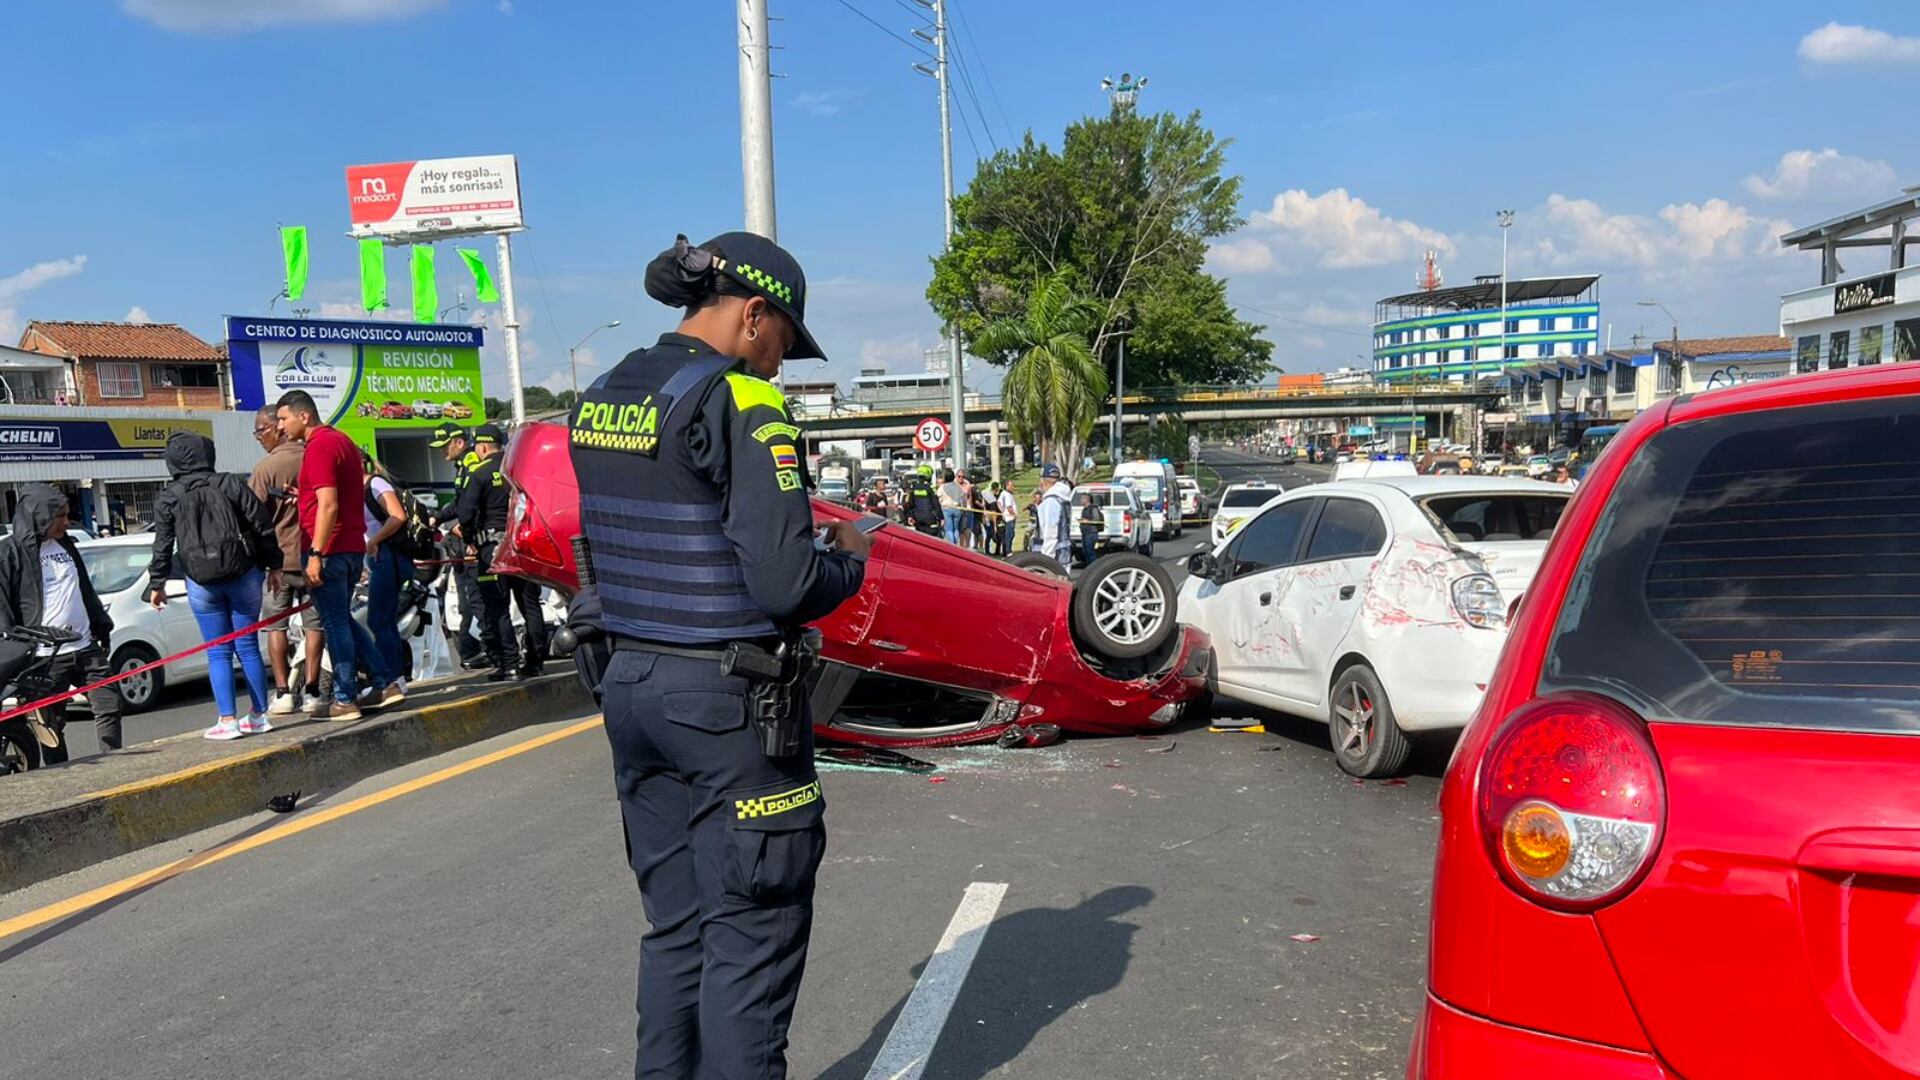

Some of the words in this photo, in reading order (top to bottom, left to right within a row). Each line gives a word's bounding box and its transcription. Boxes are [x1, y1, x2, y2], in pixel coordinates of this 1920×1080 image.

[420, 182, 445, 195] más
[449, 178, 504, 193] sonrisas!
[245, 324, 297, 338] CENTRO
[300, 327, 317, 338] DE
[319, 325, 402, 341] DIAGNÓSTICO
[405, 329, 474, 343] AUTOMOTOR
[383, 348, 454, 369] REVISIÓN
[311, 375, 337, 383] LUNA
[366, 370, 415, 393] TÉCNICO
[417, 370, 473, 393] MECÁNICA
[576, 395, 657, 435] POLICÍA
[134, 427, 165, 440] Llantas
[922, 426, 943, 442] 50
[767, 789, 814, 812] POLICÍA
